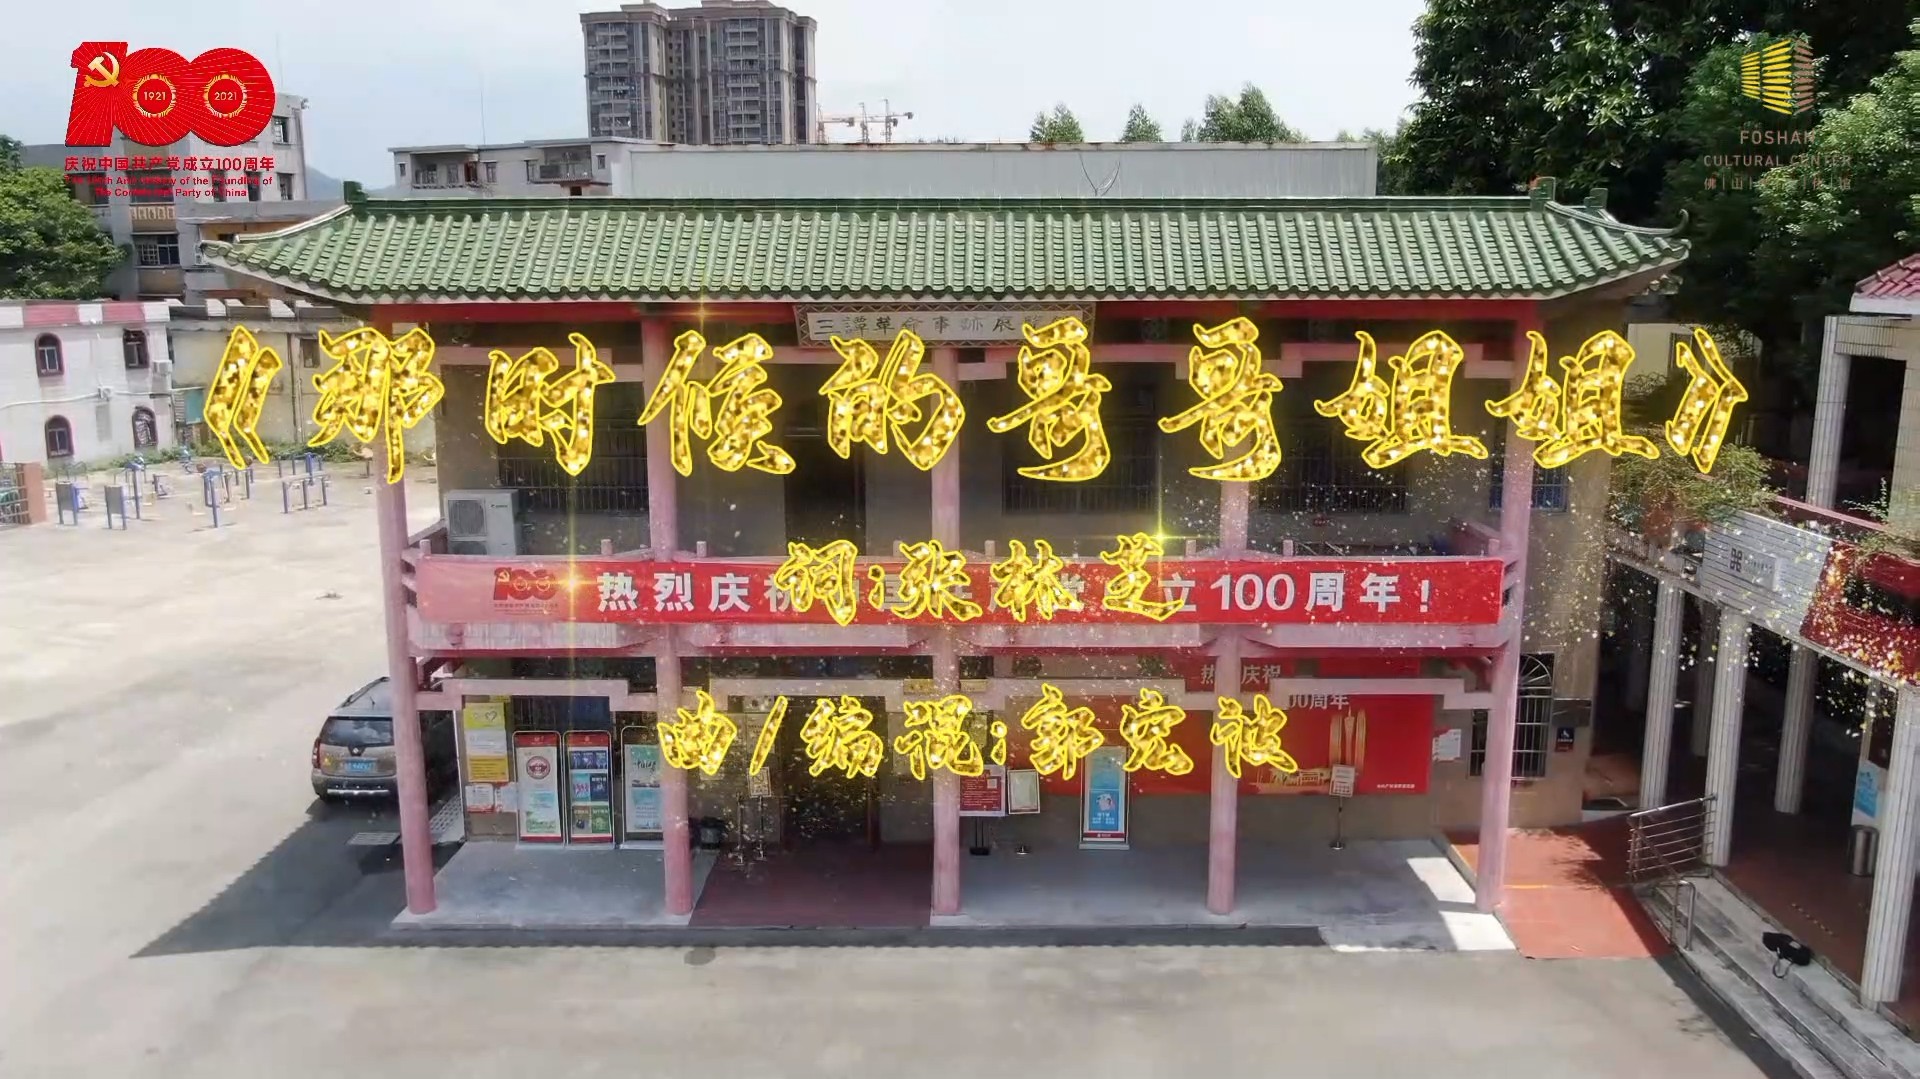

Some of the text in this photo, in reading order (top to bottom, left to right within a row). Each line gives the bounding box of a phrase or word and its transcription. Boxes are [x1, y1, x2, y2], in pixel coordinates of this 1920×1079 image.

[597, 570, 1428, 613] 热烈庆国立100周年！
[1200, 664, 1281, 684] 热庆祝
